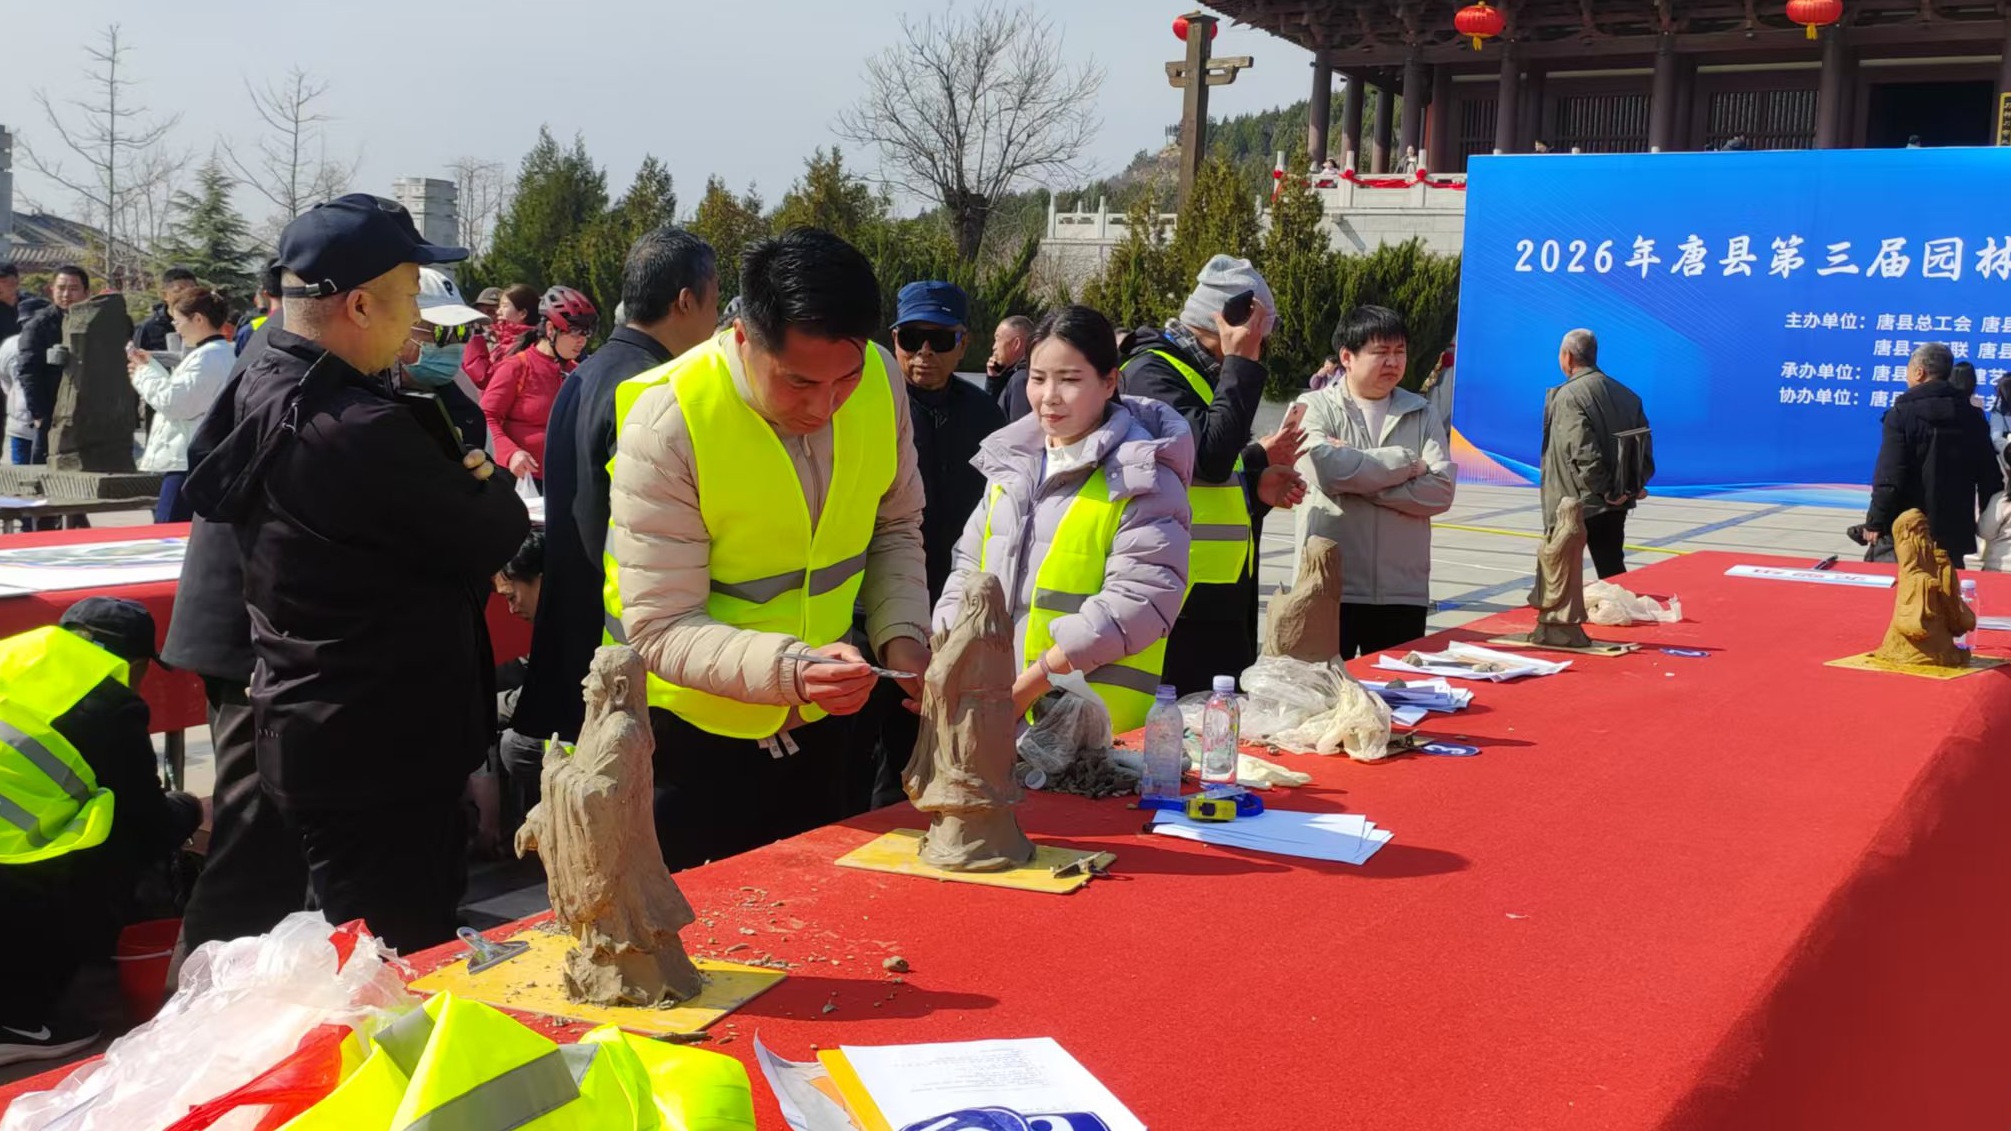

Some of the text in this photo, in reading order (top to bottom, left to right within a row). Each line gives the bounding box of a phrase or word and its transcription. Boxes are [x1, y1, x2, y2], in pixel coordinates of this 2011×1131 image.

[1515, 234, 2011, 281] 2026年唐县第三届园林
[1785, 311, 1865, 330] 主办单位：
[1876, 313, 1972, 332] 唐县总工会
[1873, 339, 1969, 358] 唐县联
[1780, 361, 1861, 380] 承办单位：
[1779, 386, 1859, 405] 协办单位：
[1423, 744, 1467, 755] 3
